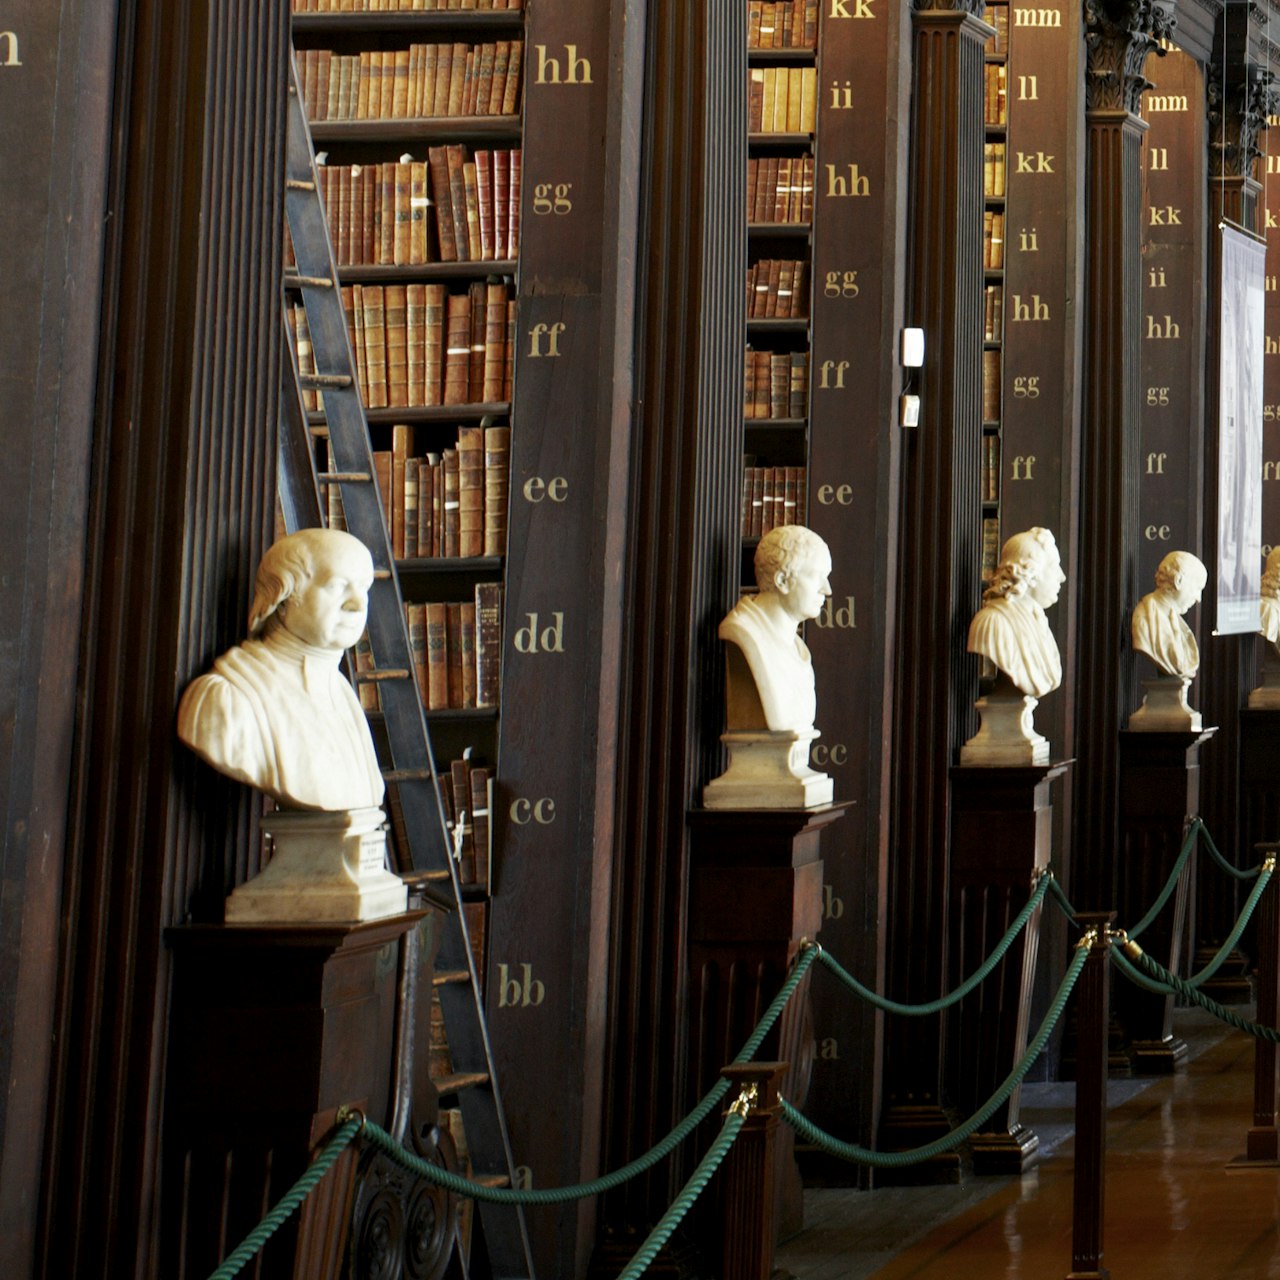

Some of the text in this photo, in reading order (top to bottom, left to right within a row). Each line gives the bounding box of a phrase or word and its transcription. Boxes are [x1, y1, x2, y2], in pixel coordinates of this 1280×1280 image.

[1013, 8, 1061, 27] mm
[534, 44, 592, 84] hh
[830, 80, 852, 109] ii
[1018, 75, 1038, 101] ll
[1148, 94, 1188, 112] mm
[1016, 151, 1054, 173] kk
[1150, 148, 1169, 170] ll
[825, 163, 870, 197] hh
[532, 183, 573, 215] gg
[1149, 206, 1182, 226] kk
[1019, 227, 1039, 252] ii
[824, 270, 859, 297] gg
[1149, 267, 1167, 288] ii
[1012, 294, 1049, 322] hh
[1146, 315, 1180, 339] hh
[527, 322, 566, 358] ff
[819, 360, 850, 389] ff
[1014, 376, 1040, 397] gg
[1146, 385, 1170, 407] gg
[1011, 455, 1036, 480] ff
[1146, 452, 1167, 474] ff
[523, 477, 568, 503] ee
[817, 484, 853, 505] ee
[1145, 525, 1170, 540] ee
[814, 596, 857, 629] dd
[513, 612, 564, 654] dd
[811, 744, 848, 766] cc
[509, 798, 556, 825] cc
[821, 884, 845, 920] b
[497, 963, 545, 1008] bb
[811, 1036, 840, 1061] a
